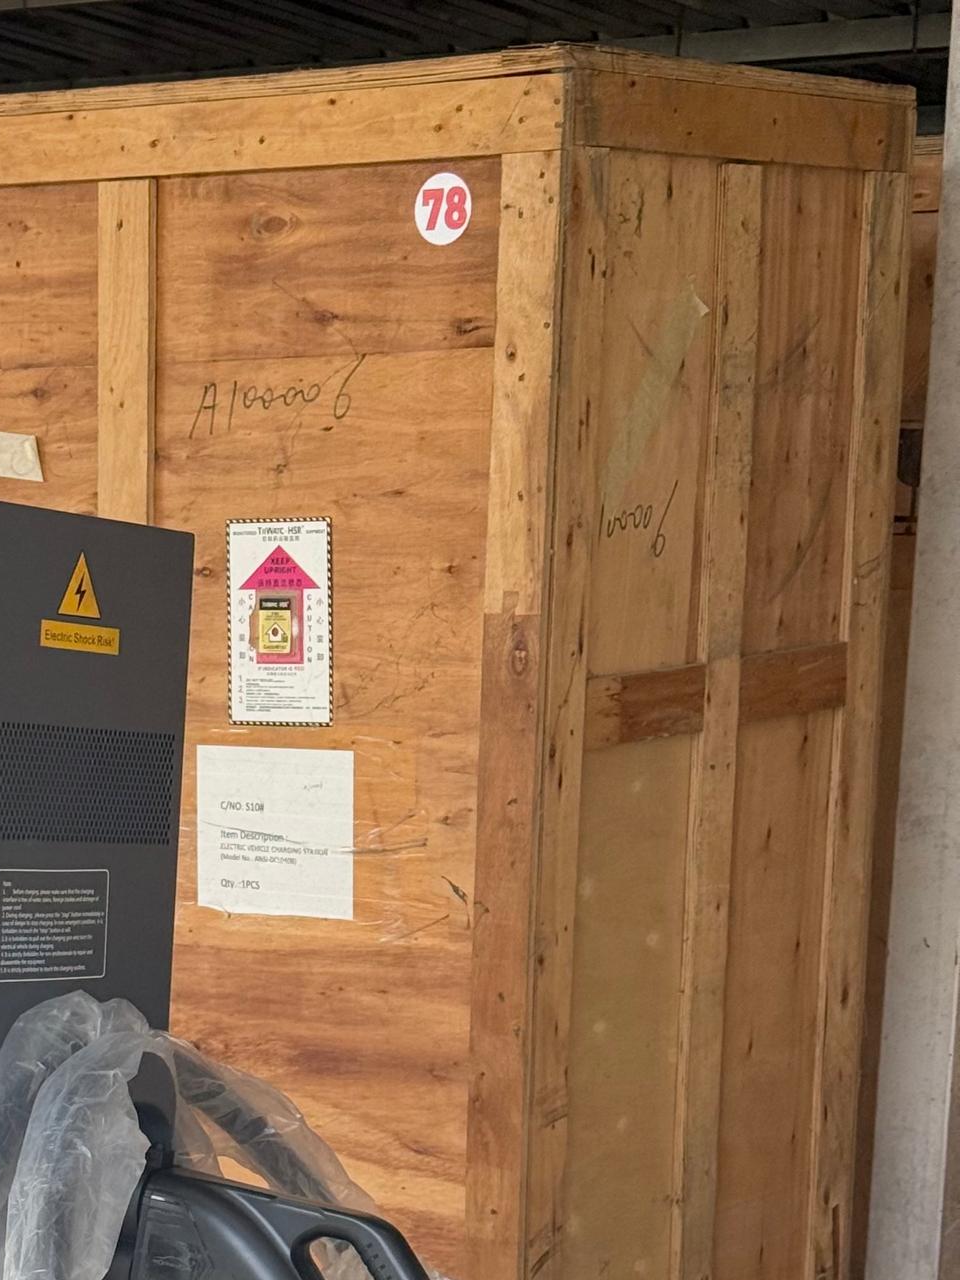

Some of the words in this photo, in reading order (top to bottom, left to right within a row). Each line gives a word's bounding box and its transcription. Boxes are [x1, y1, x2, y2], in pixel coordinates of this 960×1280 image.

[422, 186, 468, 232] 78
[270, 557, 290, 565] KEEP
[263, 566, 297, 574] UPRIGHT
[44, 628, 73, 643] Electric
[74, 631, 96, 645] Shock
[220, 830, 238, 839] Item
[219, 843, 246, 851] ELECTRIC
[247, 844, 270, 853] VEHICLE
[271, 846, 301, 855] CHARGING
